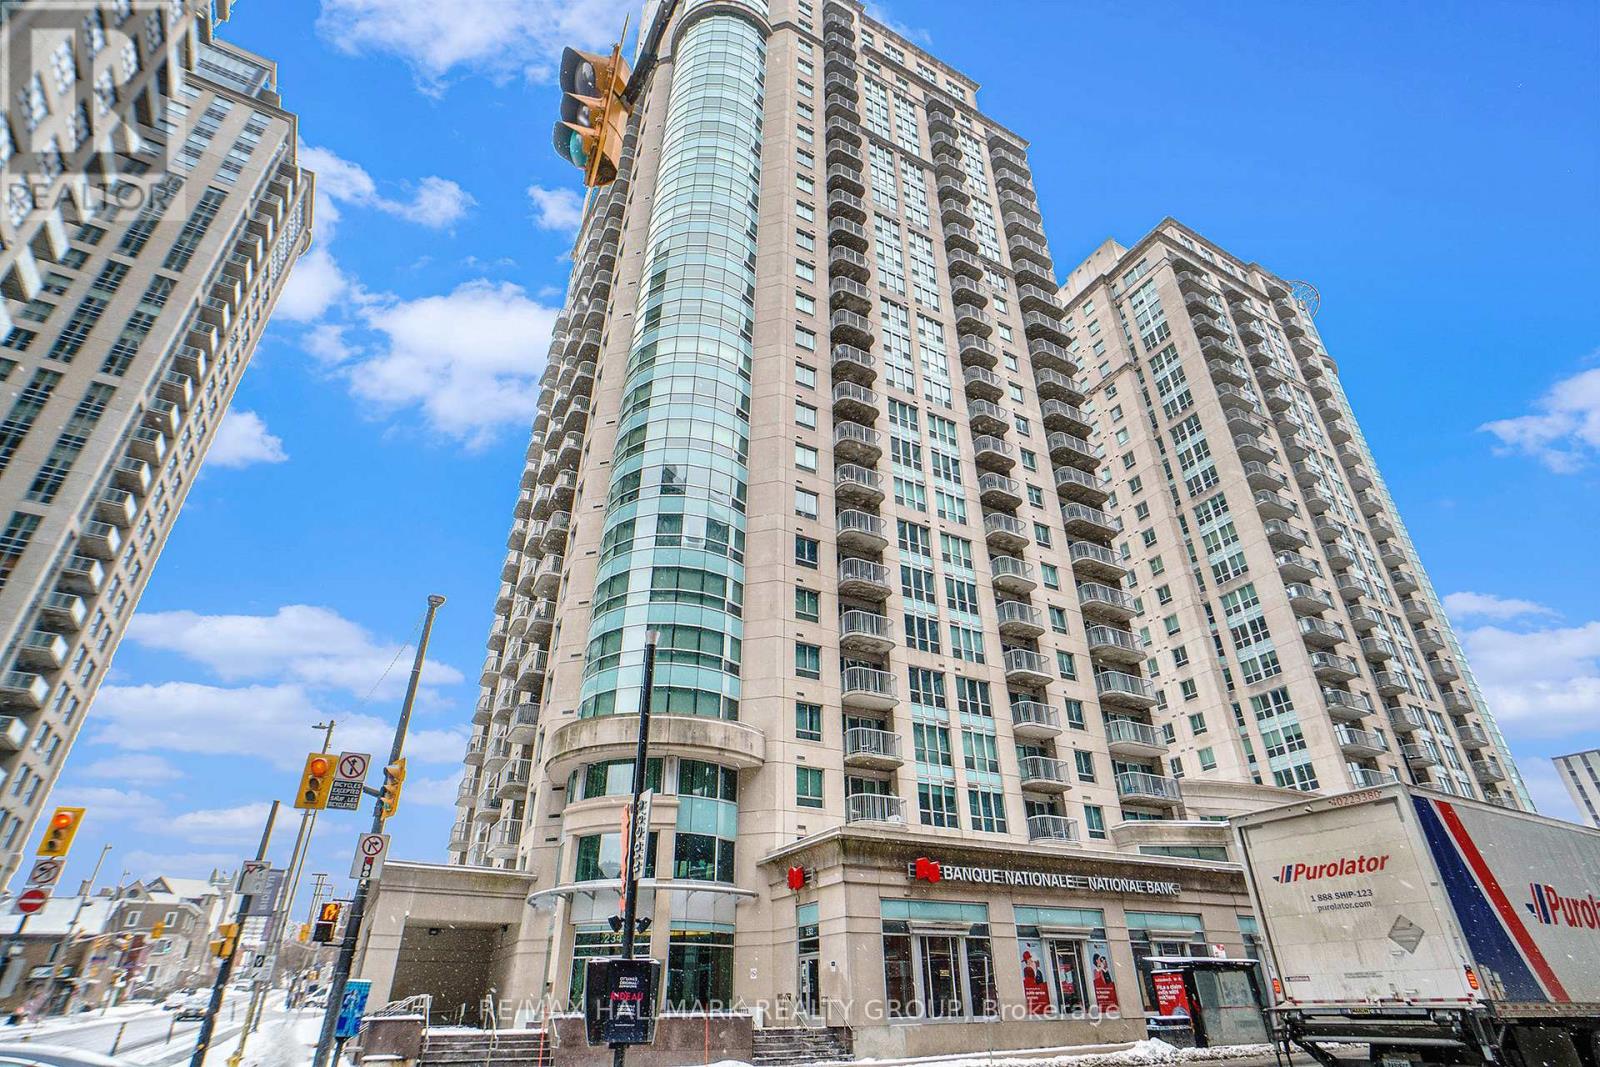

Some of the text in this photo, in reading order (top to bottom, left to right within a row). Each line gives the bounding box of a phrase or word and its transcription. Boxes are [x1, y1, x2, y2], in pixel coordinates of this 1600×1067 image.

[1293, 855, 1389, 882] Purolator
[944, 866, 1175, 895] BANQUE NATIONALE NATIONAL BANK
[1310, 888, 1373, 902] 1 888 SHIP-123
[1316, 900, 1372, 913] purolator.com
[610, 991, 644, 1001] RIDEAU
